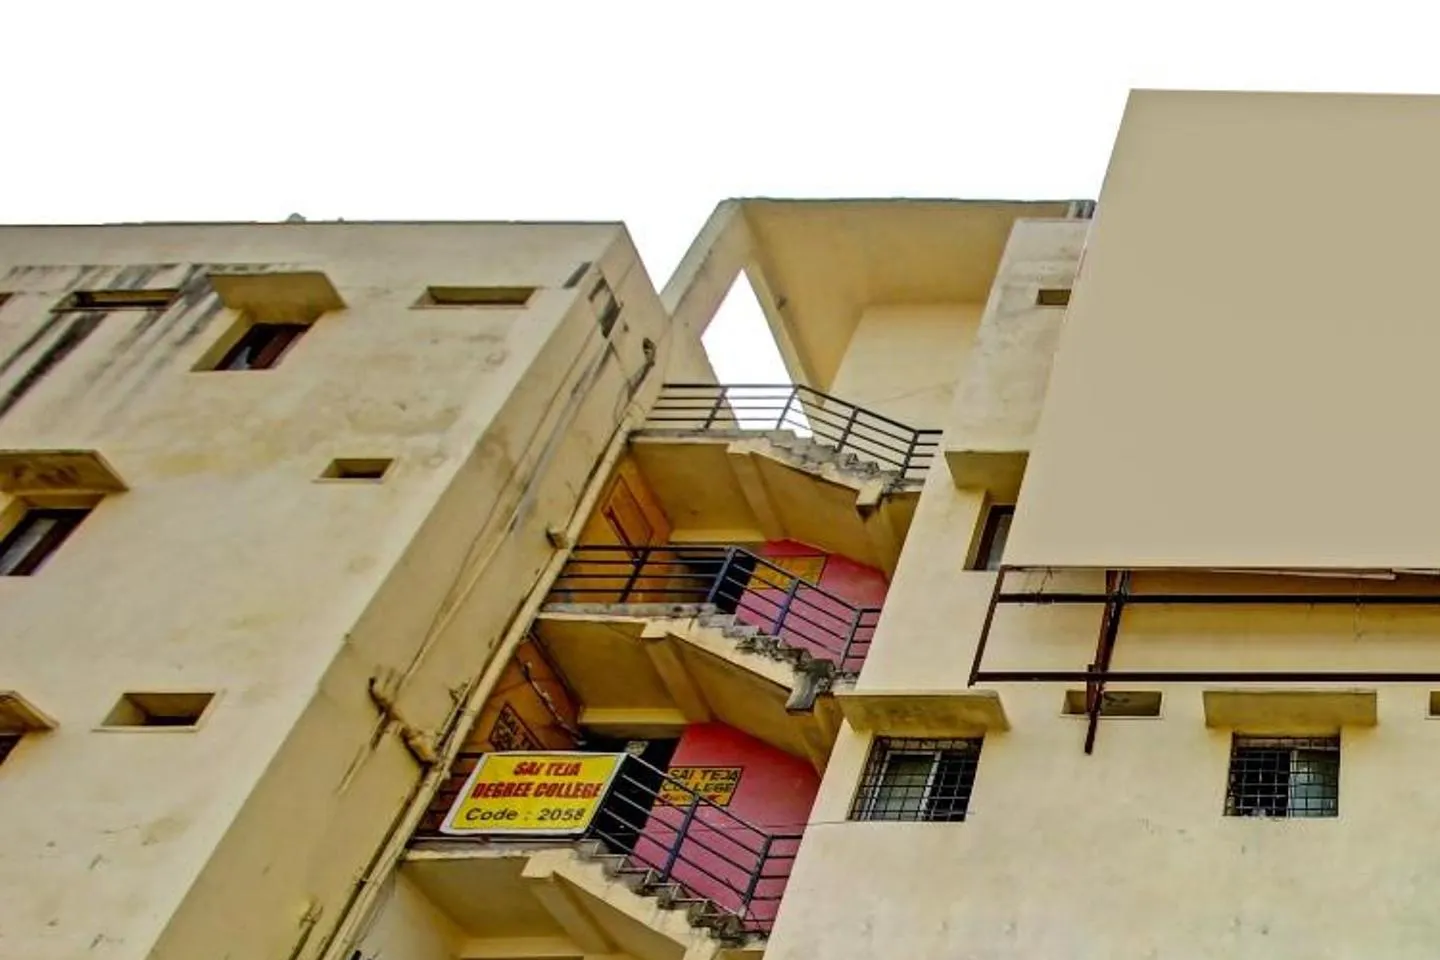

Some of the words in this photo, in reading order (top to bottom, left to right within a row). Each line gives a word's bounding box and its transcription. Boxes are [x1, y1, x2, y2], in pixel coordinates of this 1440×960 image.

[513, 762, 541, 776] SAI
[546, 762, 582, 776] TEJA
[671, 769, 695, 780] SAI
[701, 769, 738, 781] TEJA
[472, 783, 533, 798] DEGREE
[534, 782, 602, 798] COLLEGE
[466, 808, 519, 821] Code
[537, 807, 586, 821] 2058
